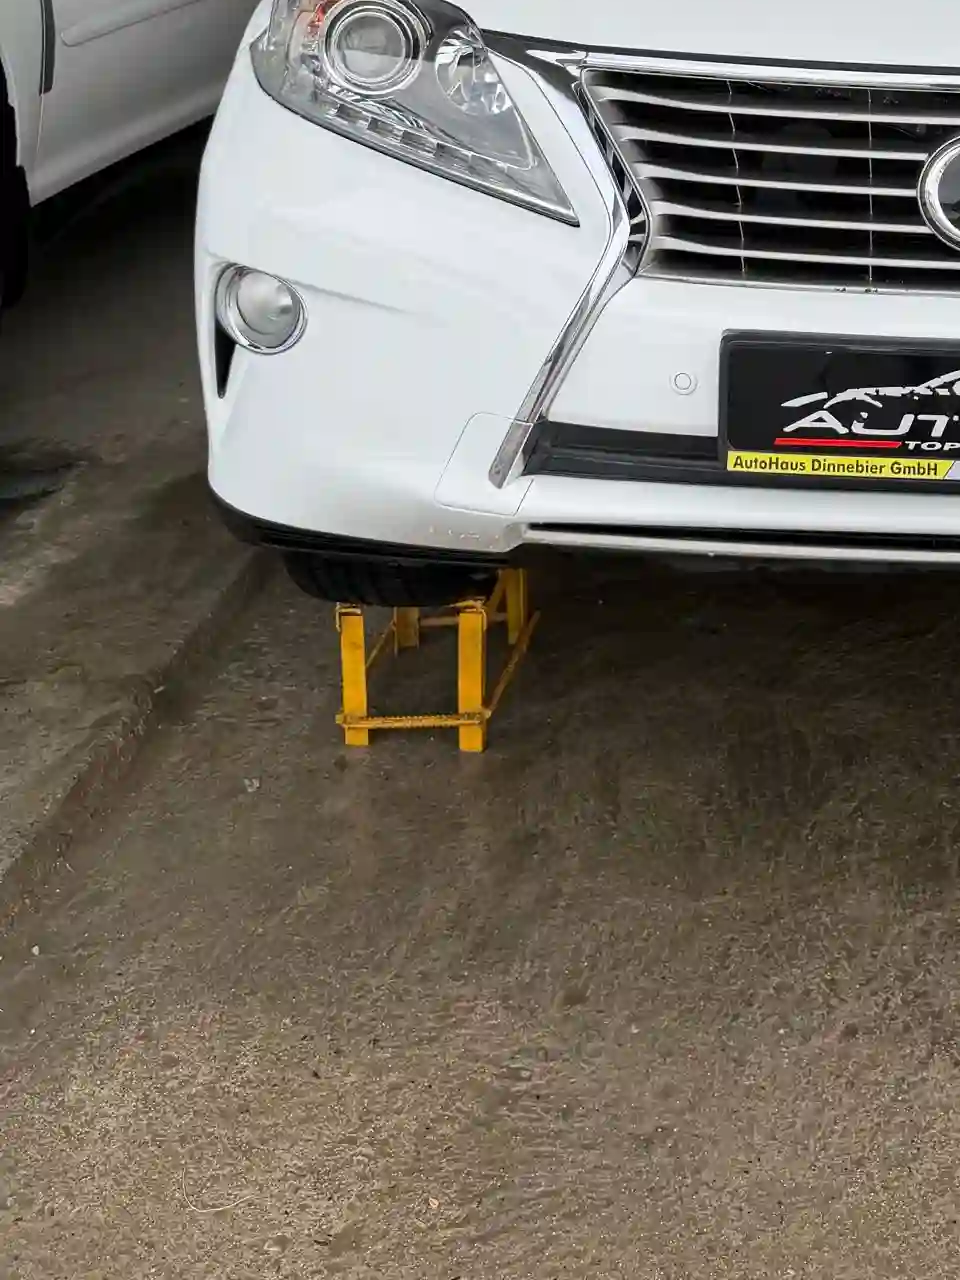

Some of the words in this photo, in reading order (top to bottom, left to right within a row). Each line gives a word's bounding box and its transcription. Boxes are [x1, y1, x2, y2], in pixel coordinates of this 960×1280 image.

[904, 440, 960, 452] TOP
[733, 455, 806, 472] AutoHaus
[811, 458, 885, 475] Dinnebier
[890, 461, 938, 477] GmbH
